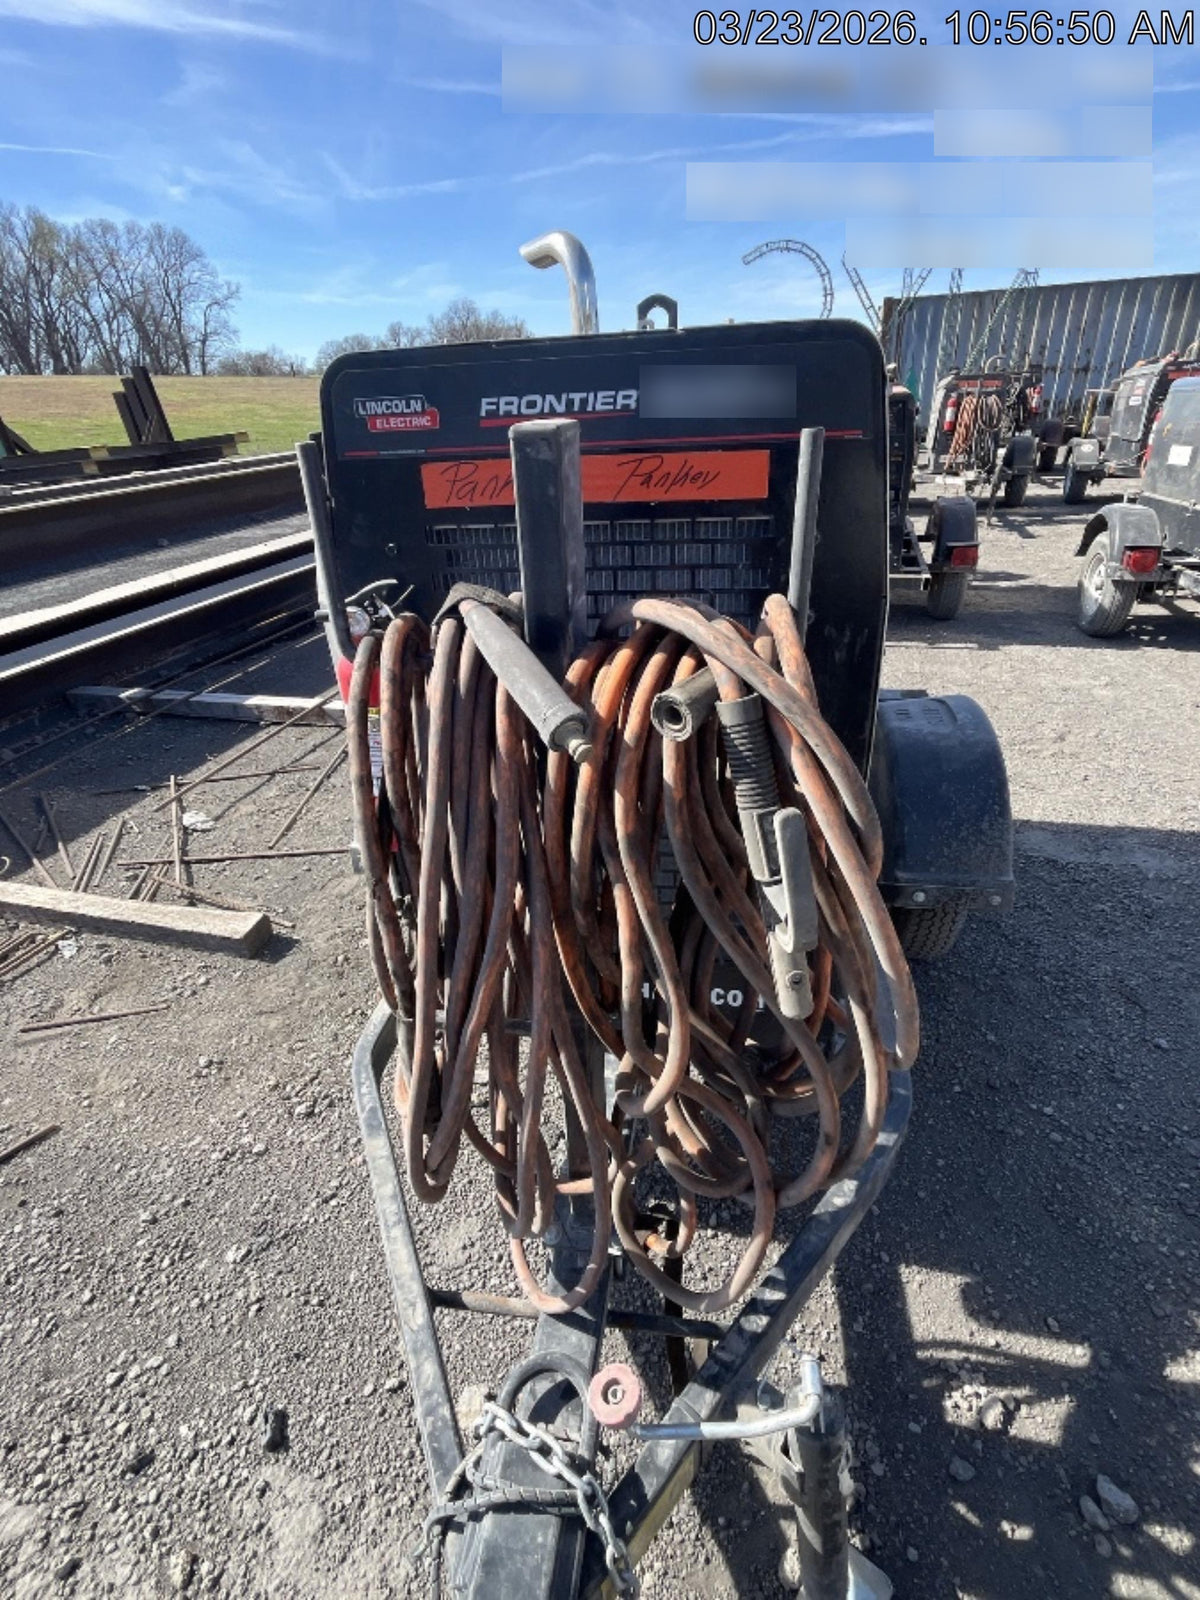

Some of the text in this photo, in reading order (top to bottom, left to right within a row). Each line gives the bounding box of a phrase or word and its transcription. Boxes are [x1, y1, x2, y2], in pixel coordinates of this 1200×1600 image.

[358, 399, 422, 415] LINCOLN
[479, 388, 640, 417] FRONTIER
[375, 415, 432, 429] ELECTRIC
